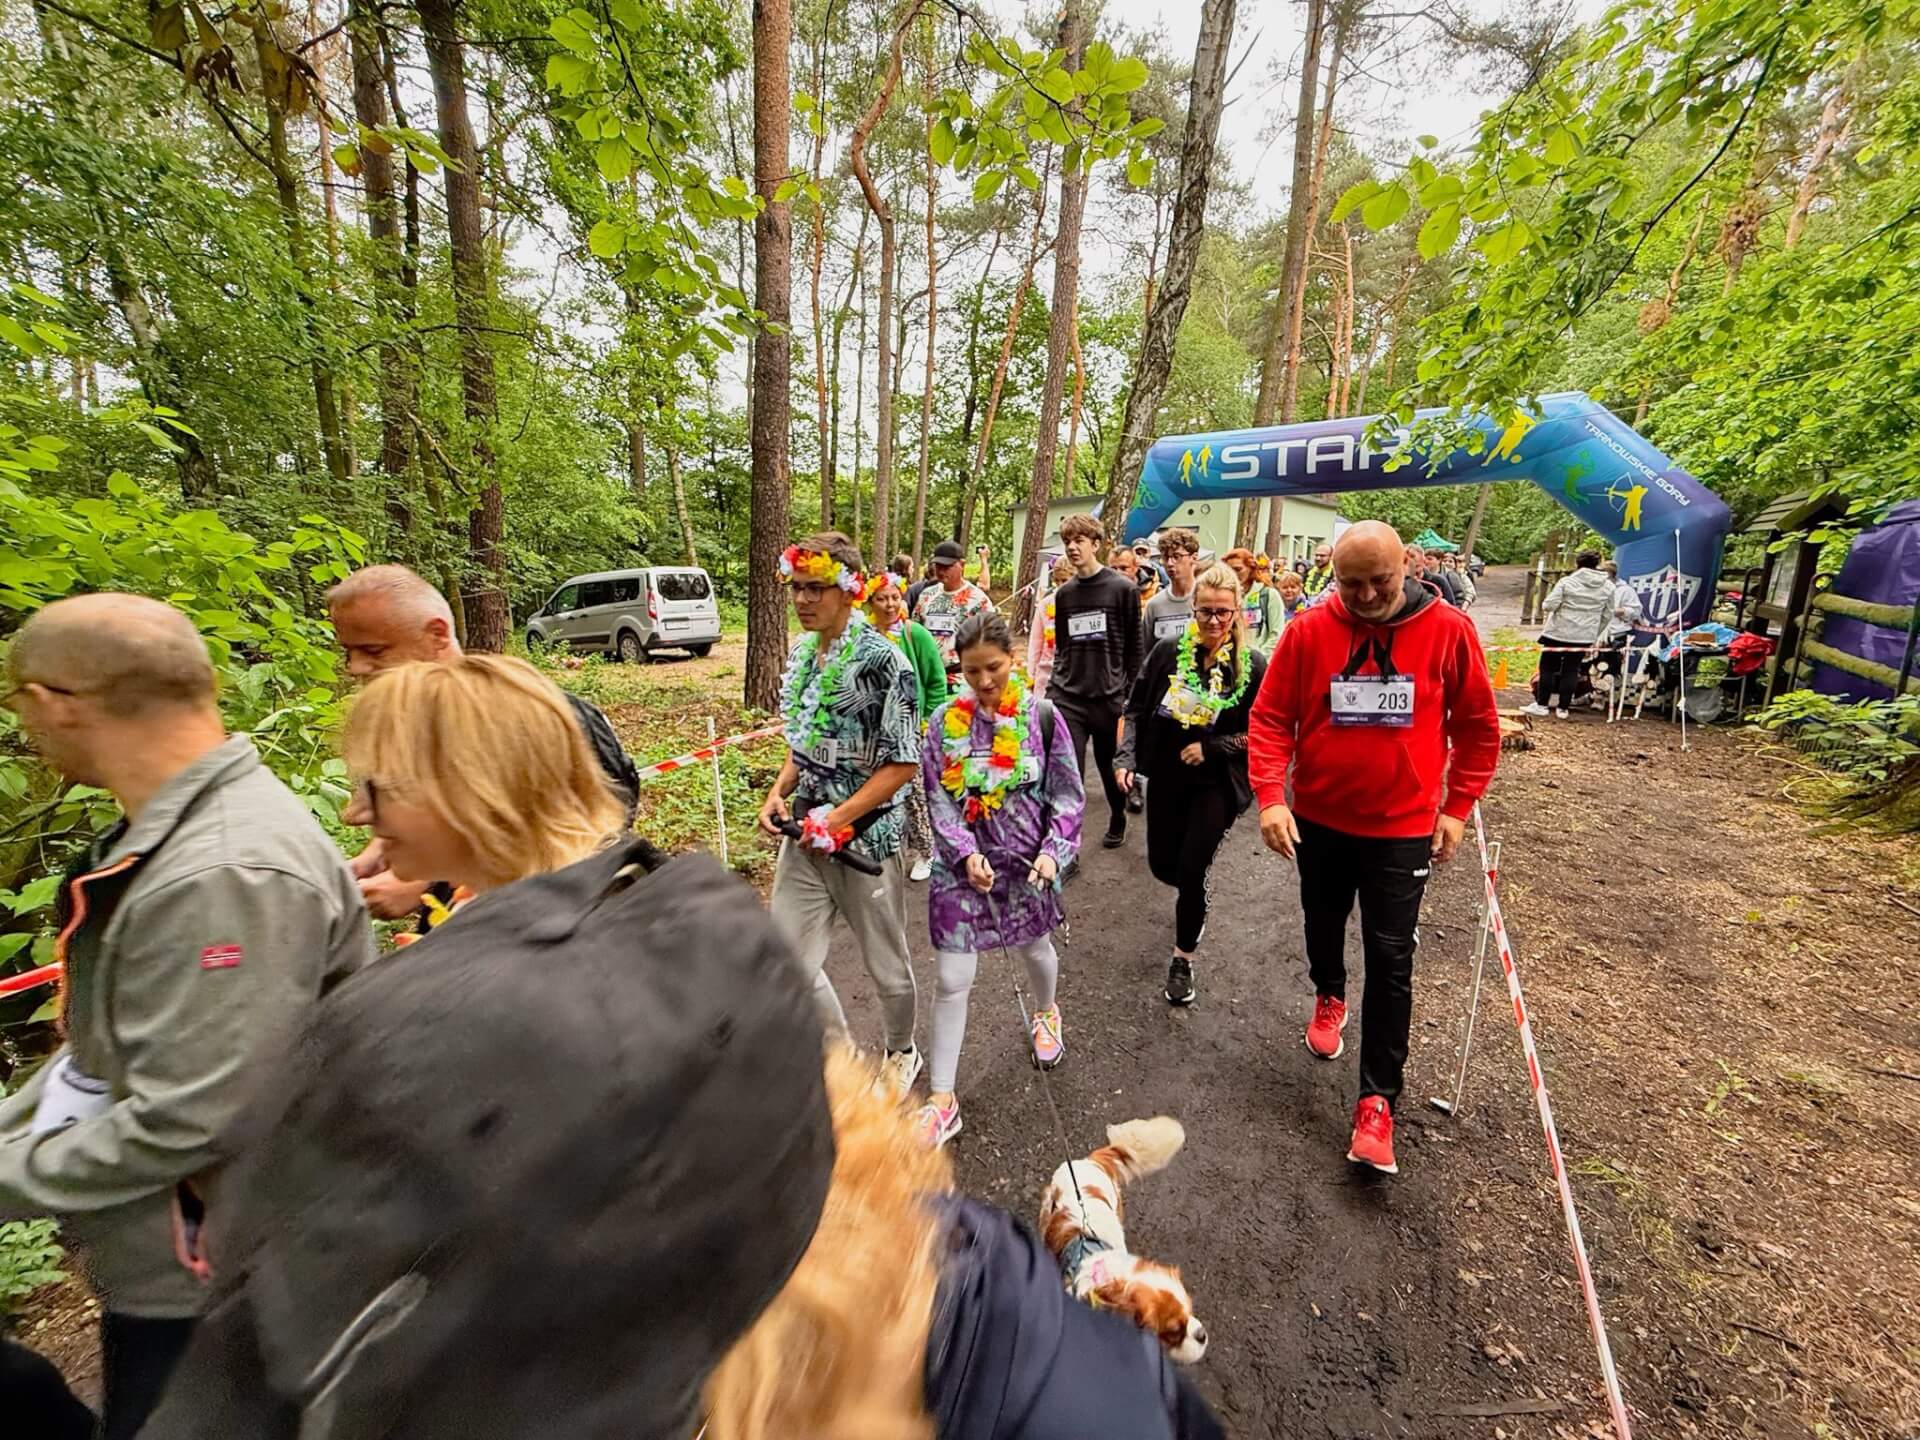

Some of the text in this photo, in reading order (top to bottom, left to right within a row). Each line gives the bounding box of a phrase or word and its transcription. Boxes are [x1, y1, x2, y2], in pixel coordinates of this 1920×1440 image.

[1220, 428, 1437, 481] STAR
[1584, 420, 1691, 506] TARNOWSKIE GÓRY
[1378, 692, 1408, 710] 203
